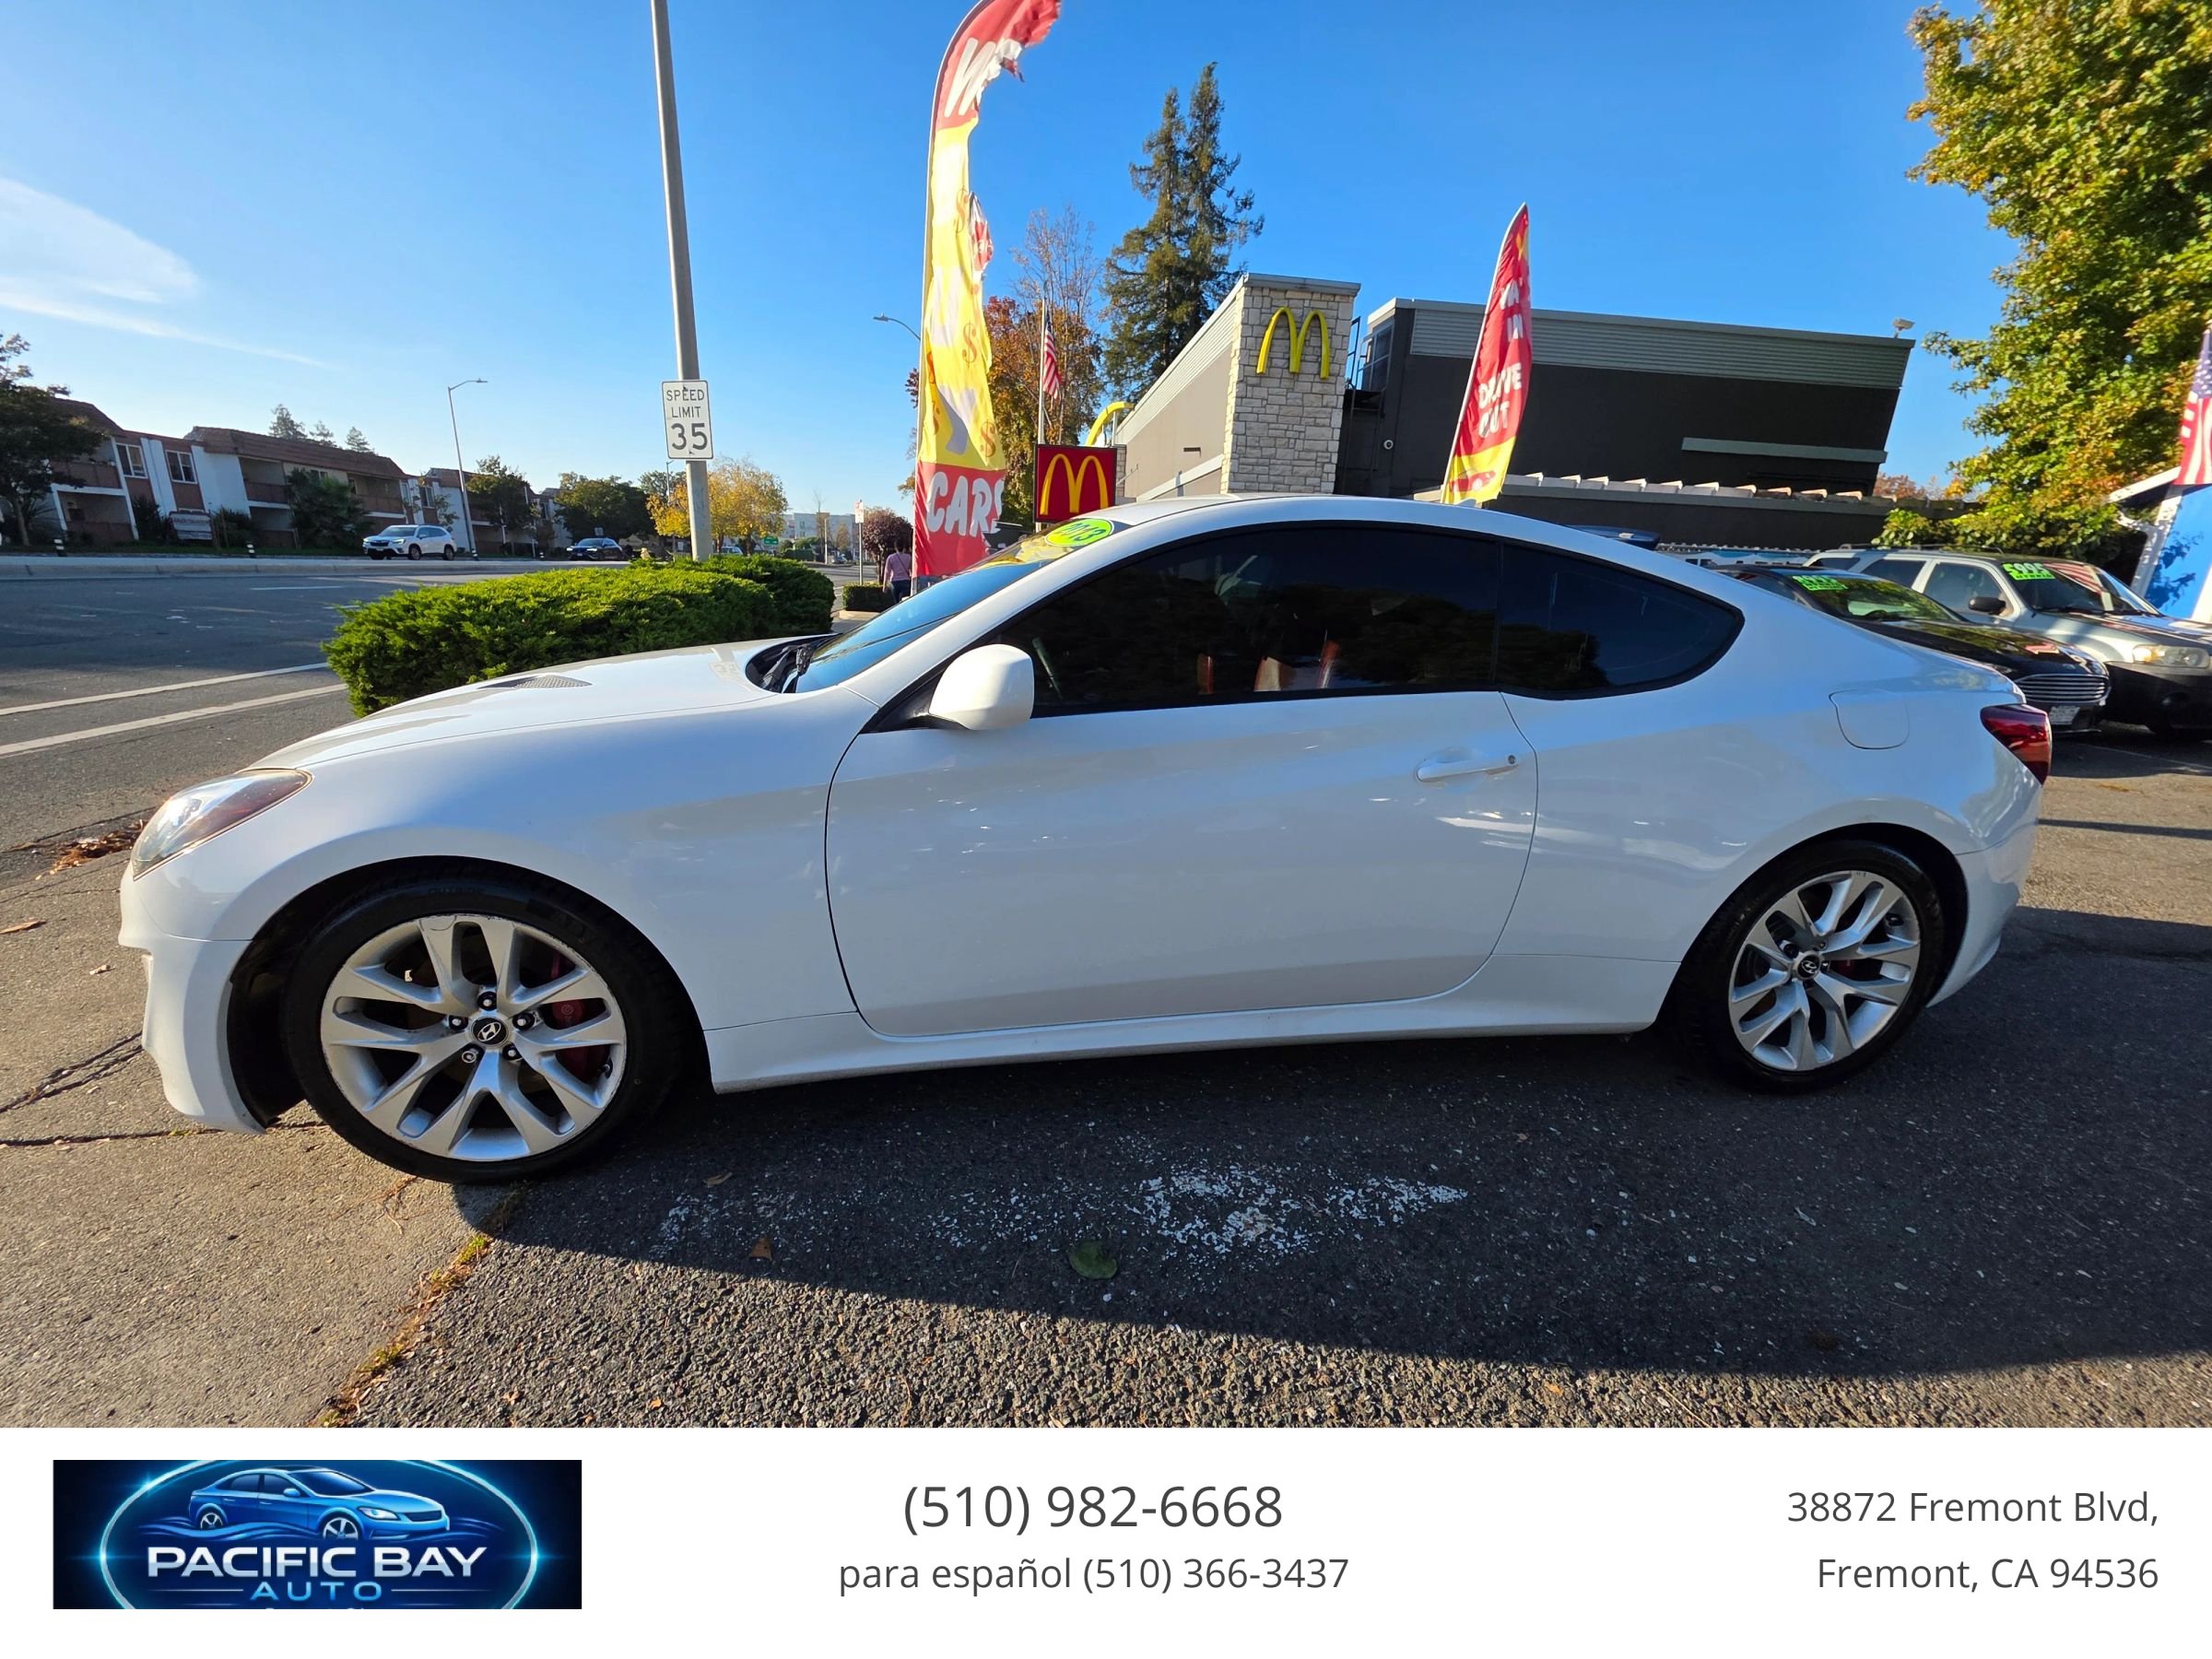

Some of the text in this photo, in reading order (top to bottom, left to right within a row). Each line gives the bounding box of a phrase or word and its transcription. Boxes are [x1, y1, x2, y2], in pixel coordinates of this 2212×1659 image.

[666, 389, 705, 401] SPEED
[671, 406, 701, 418] LIMIT
[670, 422, 708, 451] 35
